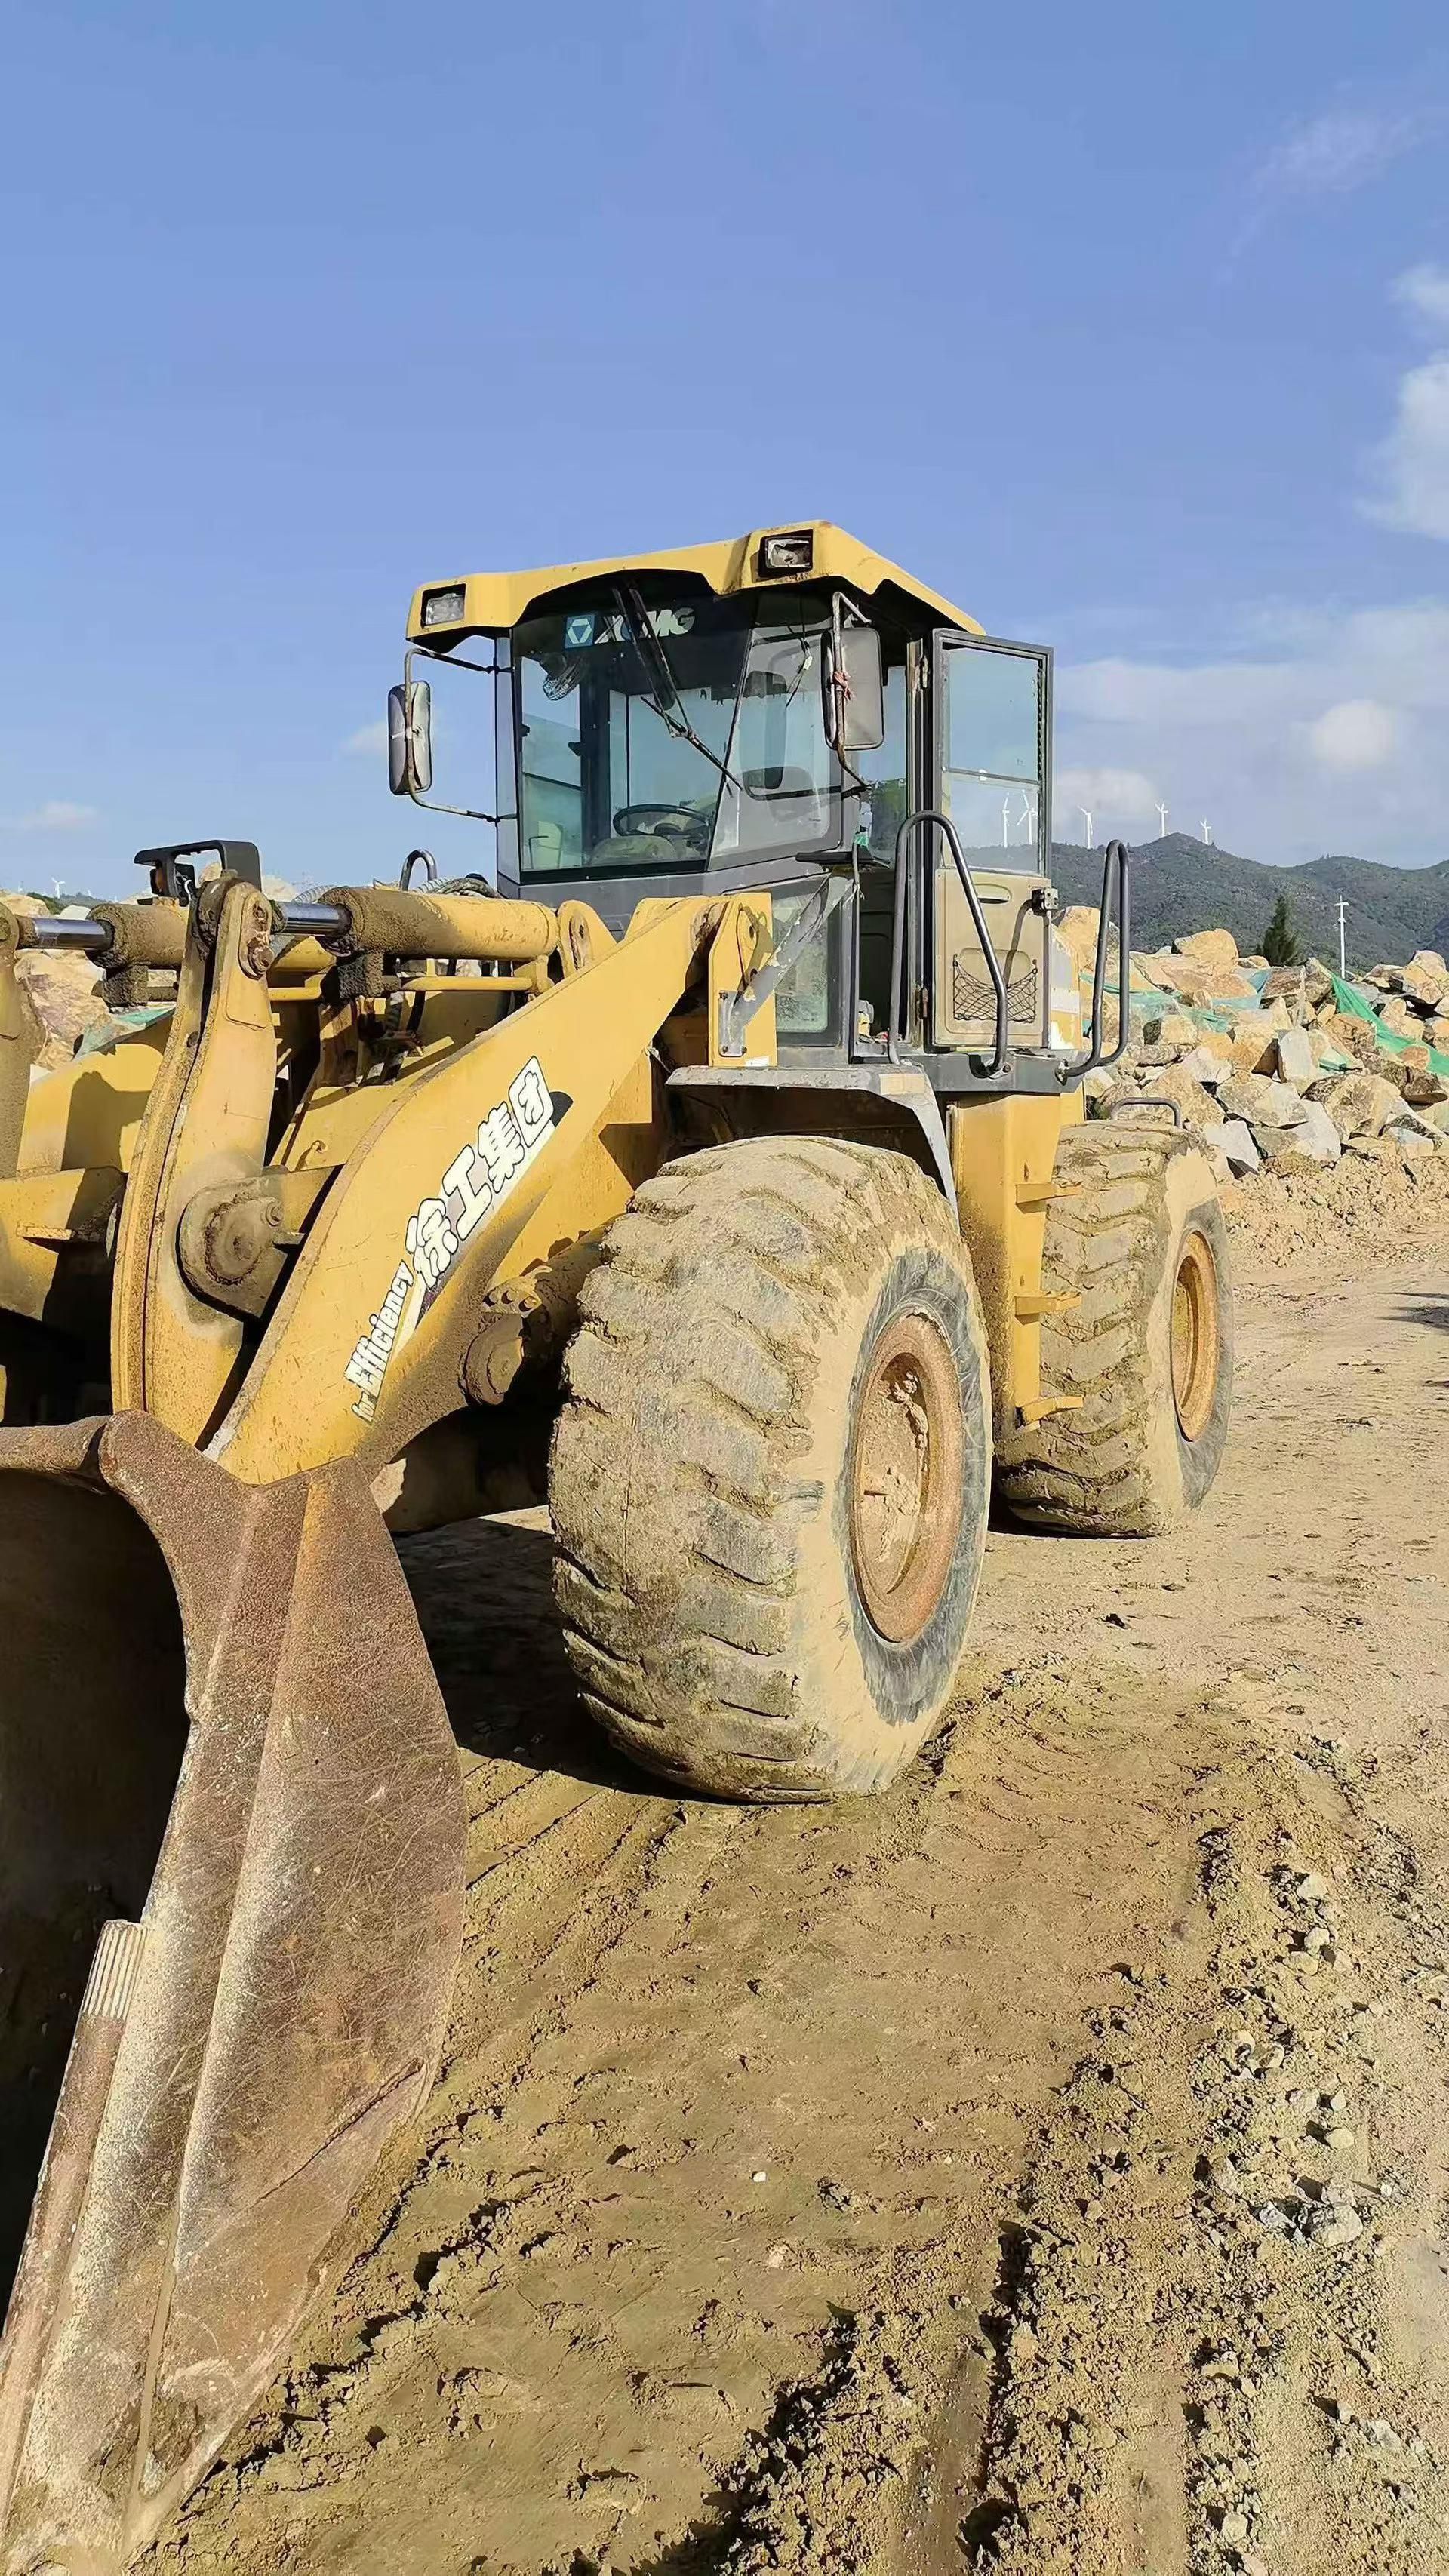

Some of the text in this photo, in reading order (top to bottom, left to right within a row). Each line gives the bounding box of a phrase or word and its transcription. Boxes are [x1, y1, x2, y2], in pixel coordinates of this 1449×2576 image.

[405, 1055, 554, 1290] 徐工集团
[343, 1259, 414, 1399] Efficiency
